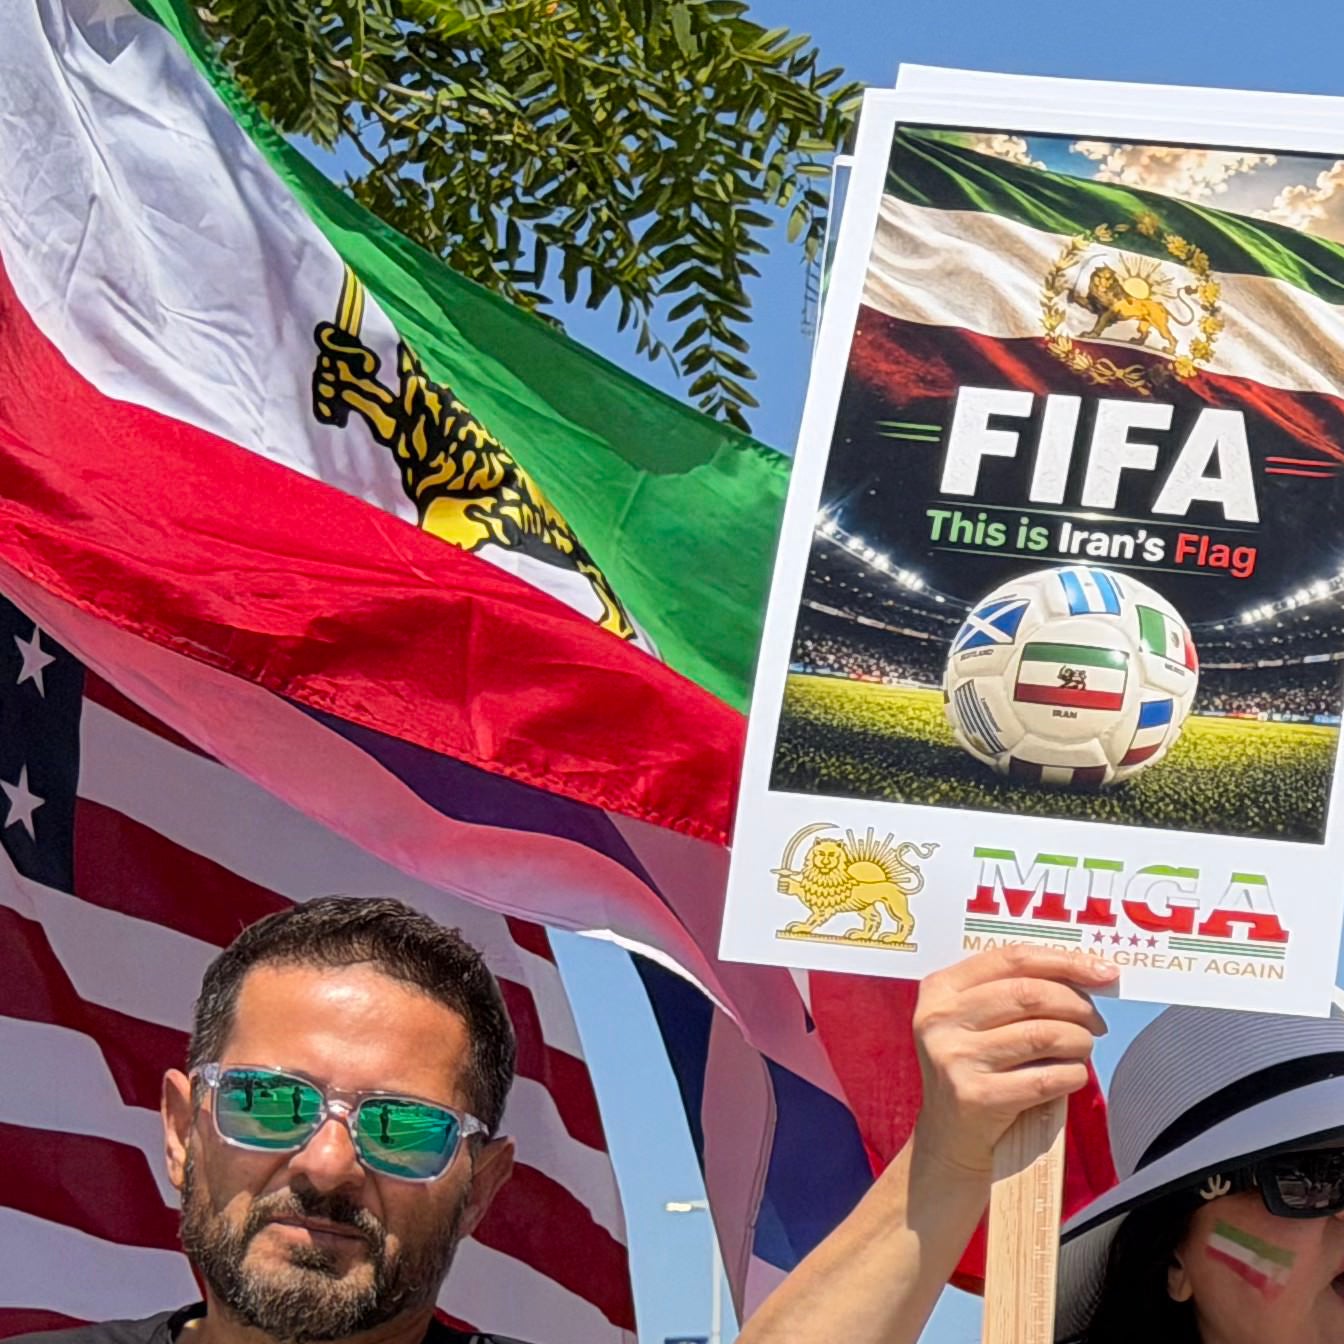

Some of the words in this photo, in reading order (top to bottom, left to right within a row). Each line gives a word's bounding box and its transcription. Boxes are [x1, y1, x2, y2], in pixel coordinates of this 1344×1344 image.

[939, 386, 1261, 523] FIFA
[926, 509, 1006, 547] This
[1016, 517, 1048, 552] is
[1058, 522, 1166, 563] Iran's
[1173, 532, 1258, 578] Flag
[1052, 710, 1078, 720] IRAN
[966, 846, 1290, 943] MIGA
[1113, 950, 1197, 971] GREAT
[1204, 959, 1284, 979] AGAIN
